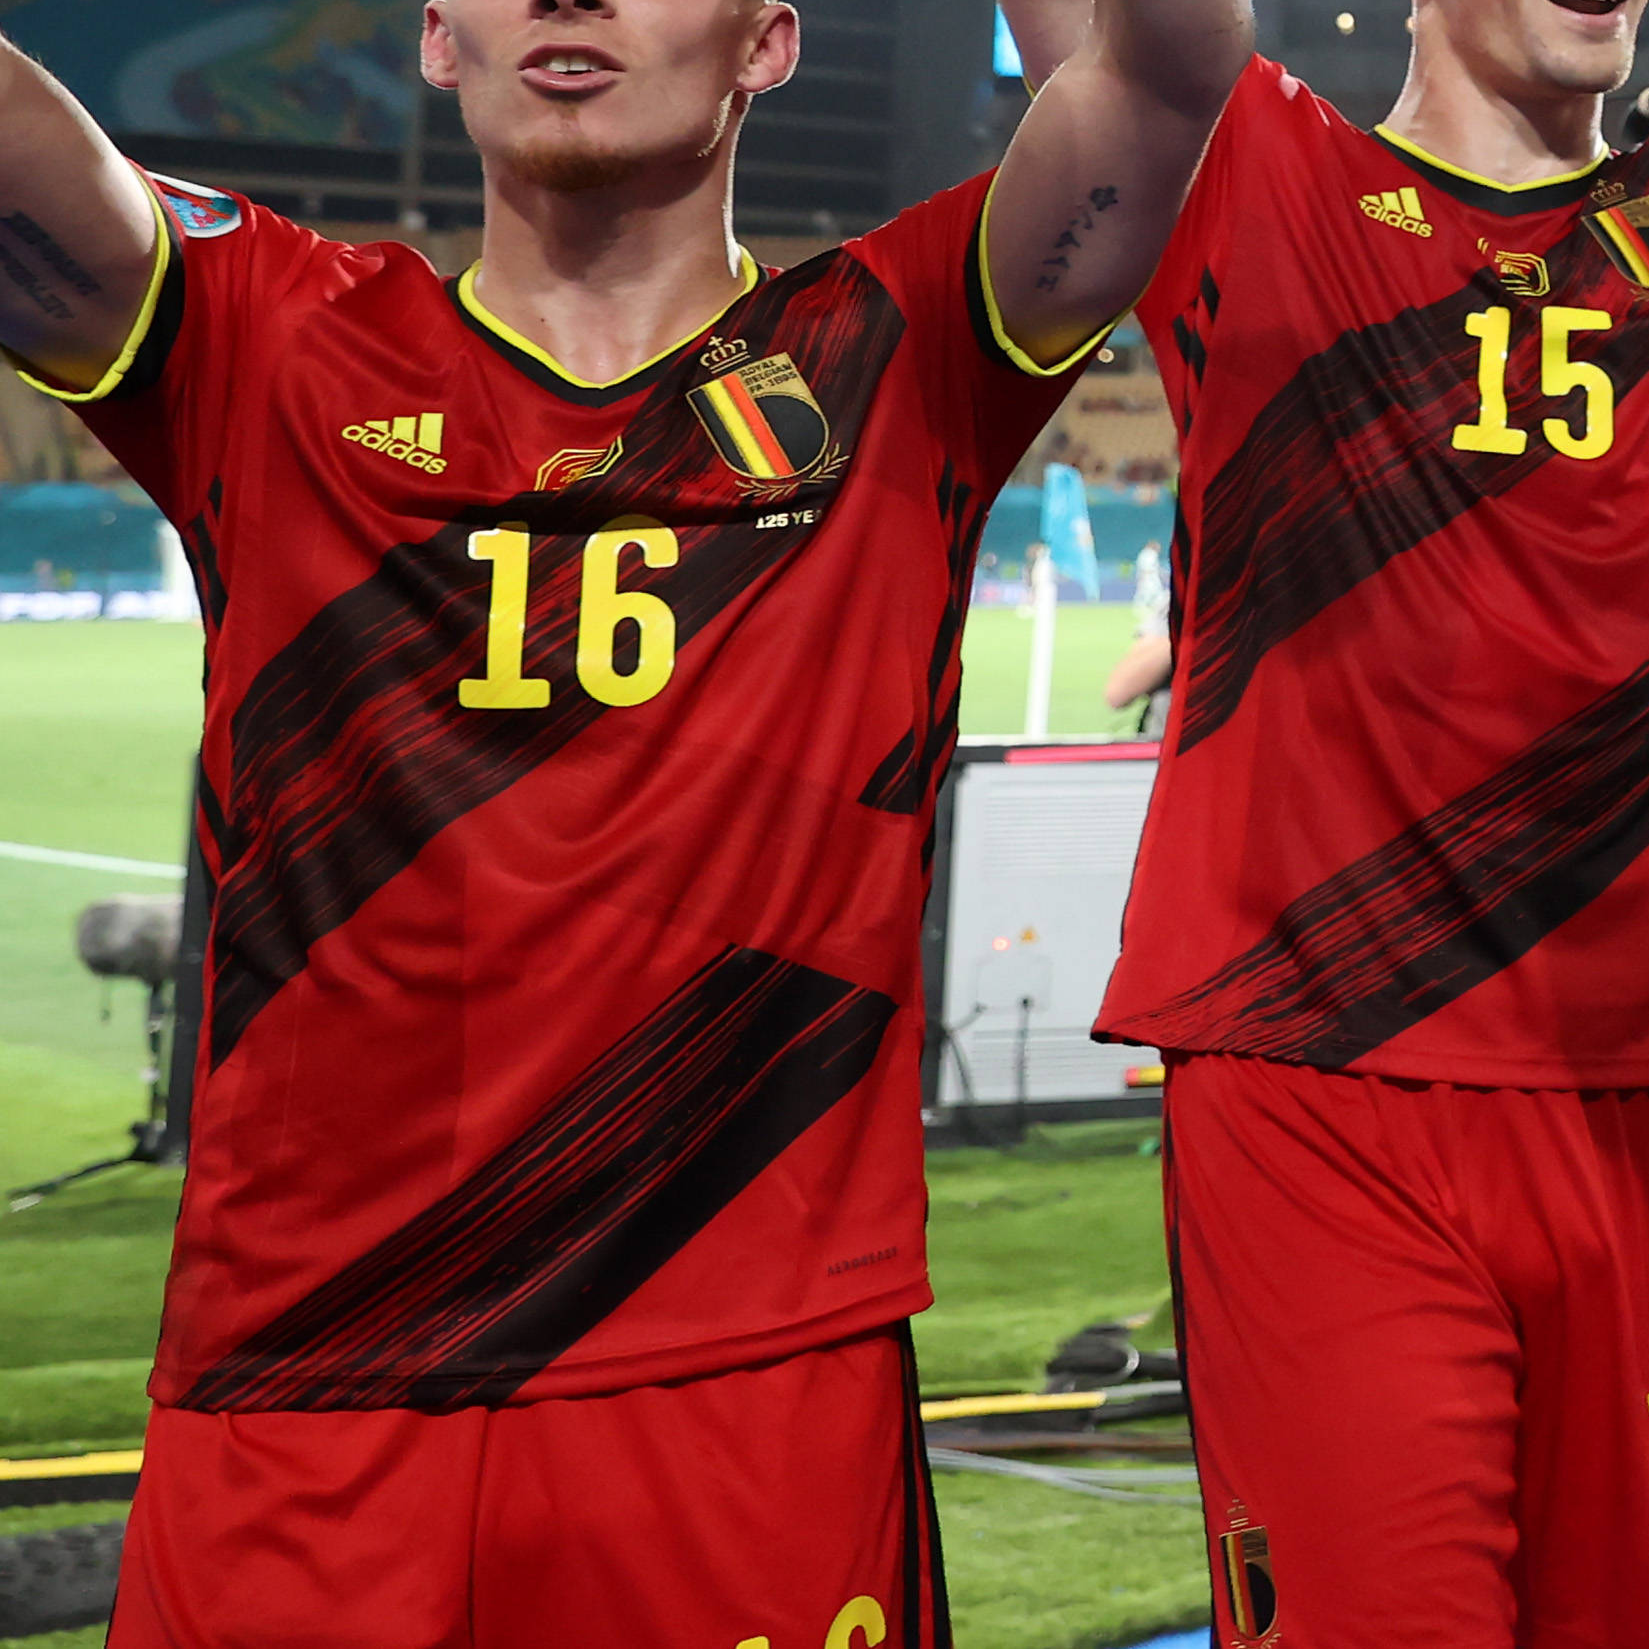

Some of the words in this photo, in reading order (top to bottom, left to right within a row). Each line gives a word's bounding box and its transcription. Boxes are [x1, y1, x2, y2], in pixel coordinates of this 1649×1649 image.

[341, 423, 448, 475] adidas
[1452, 305, 1614, 460] 15
[458, 517, 680, 710] 16
